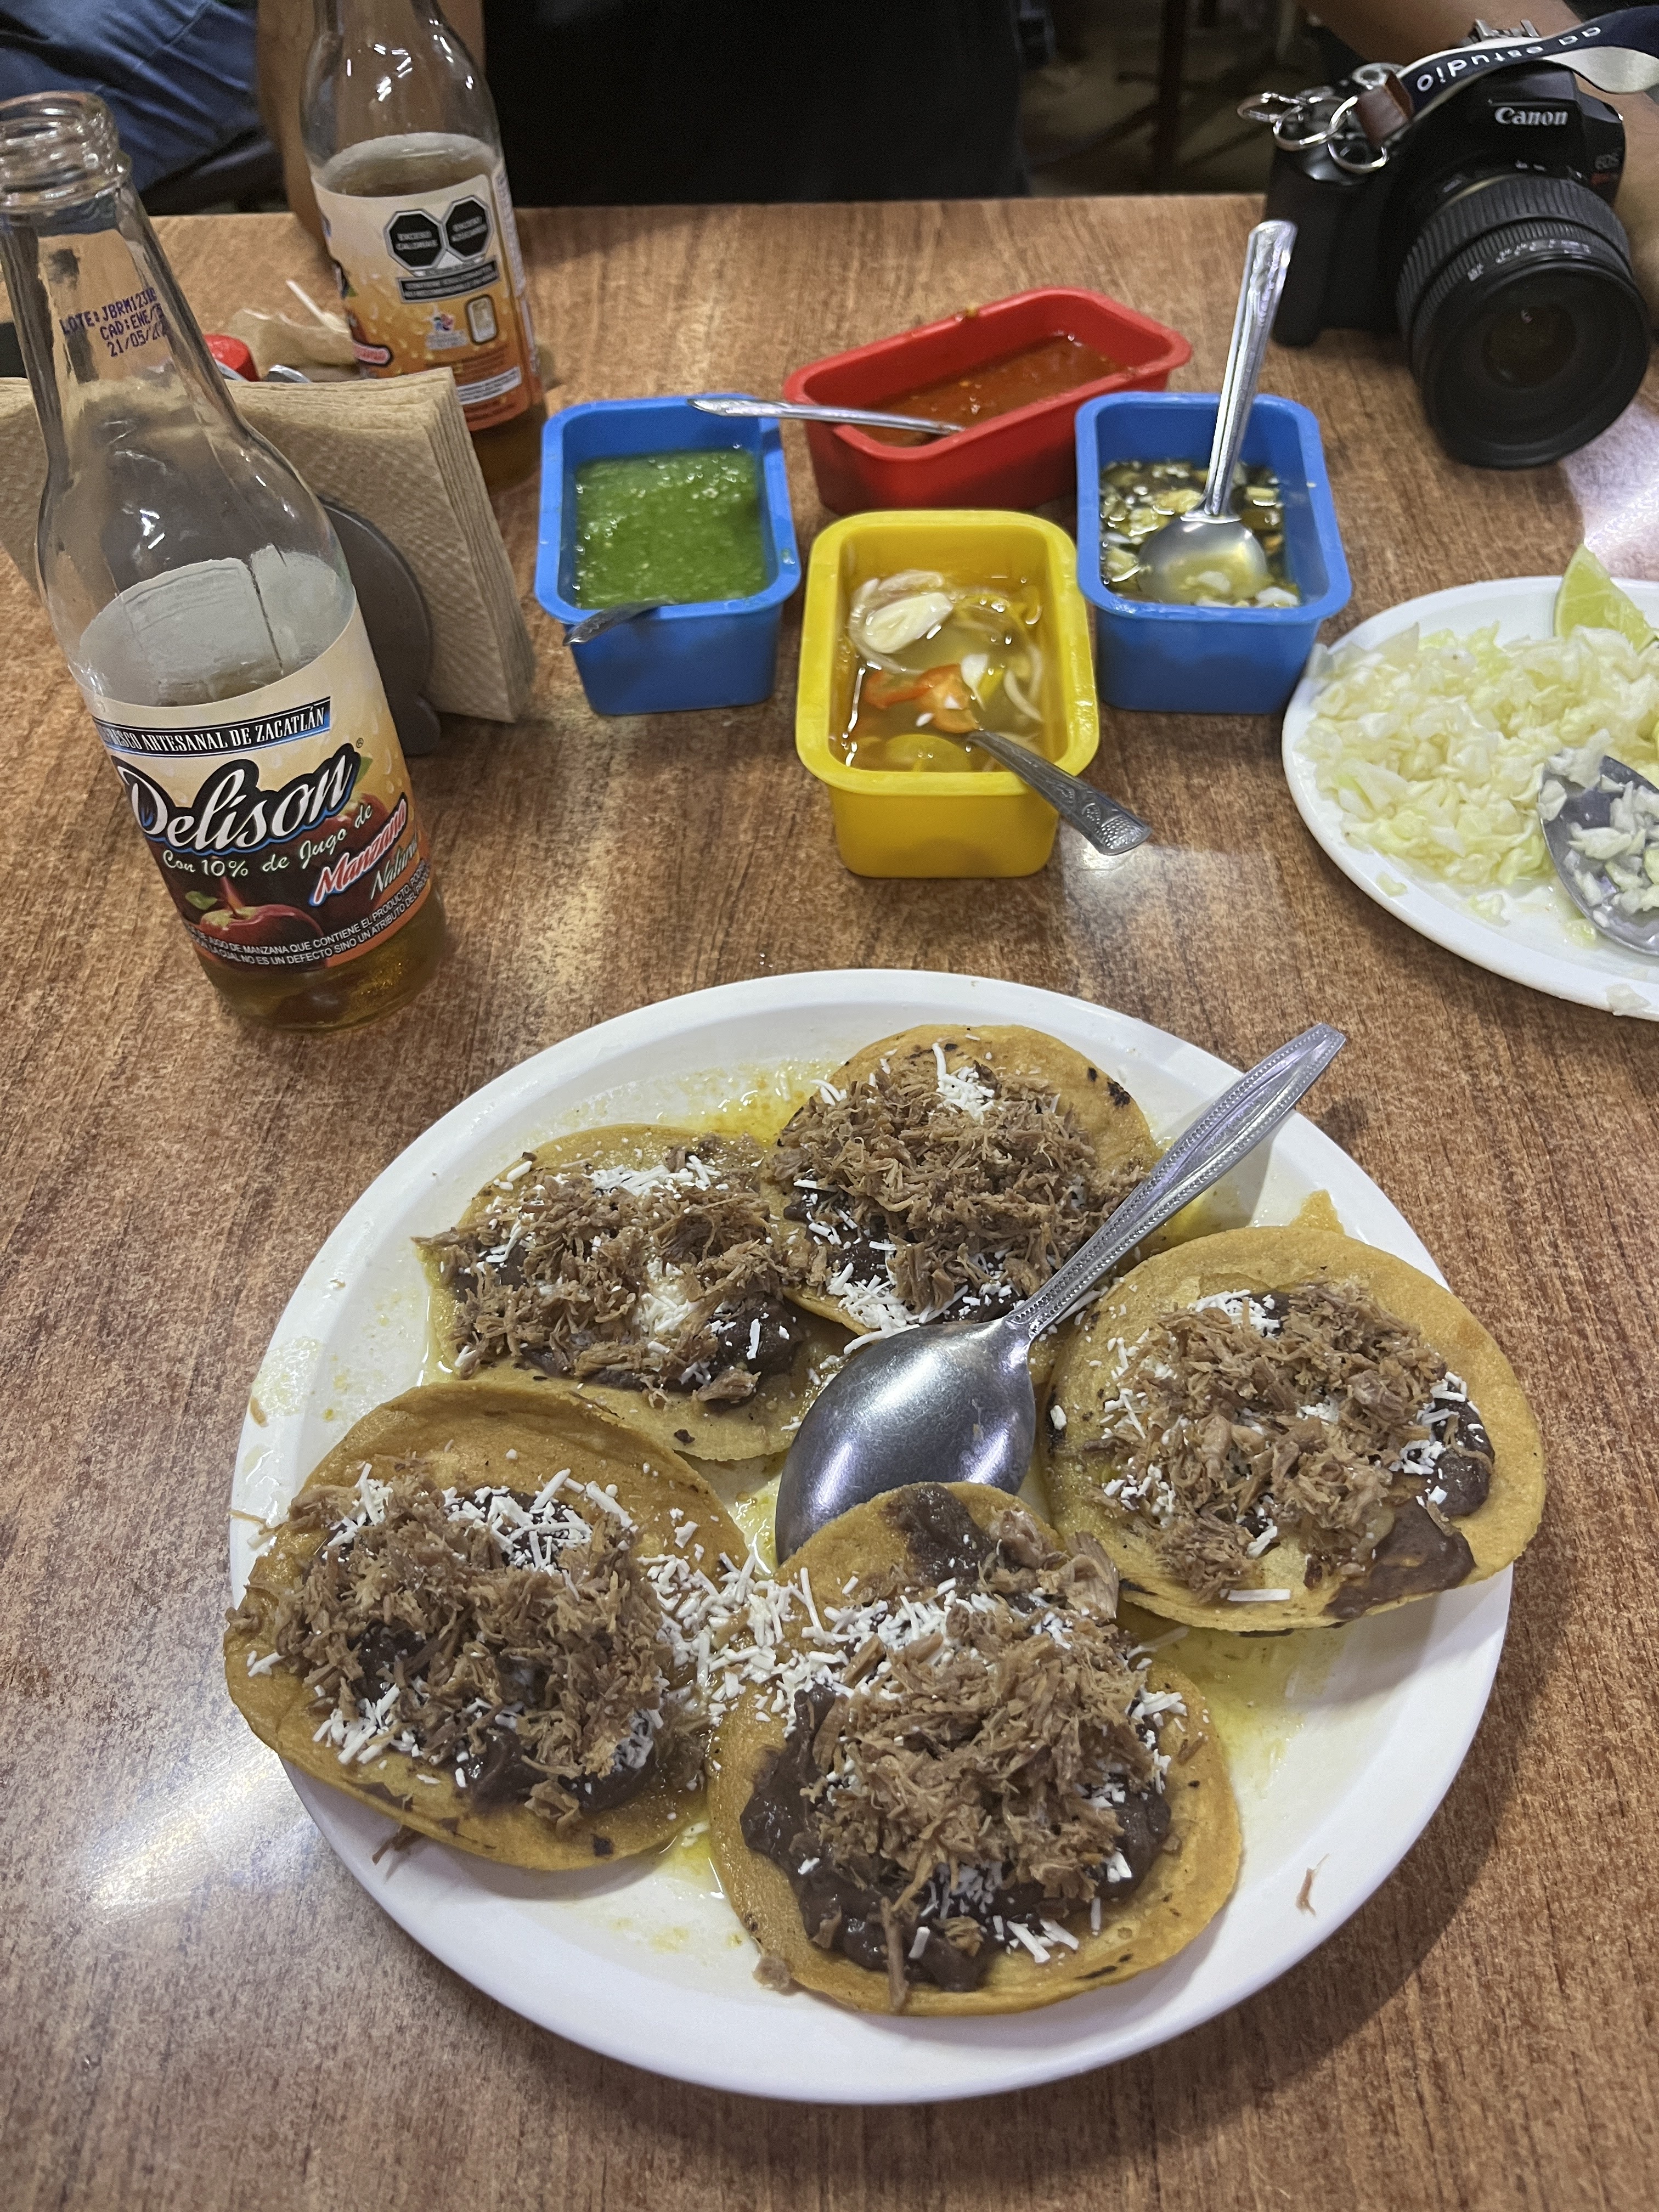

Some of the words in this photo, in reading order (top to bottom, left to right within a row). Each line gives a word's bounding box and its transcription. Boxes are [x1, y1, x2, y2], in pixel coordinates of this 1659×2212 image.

[1494, 106, 1568, 126] Canon
[141, 731, 228, 752] ARTESANAL
[229, 727, 252, 747] DE
[255, 706, 324, 743] ZACATLÁN
[117, 754, 353, 850] Delison
[162, 849, 196, 873] Con
[201, 859, 249, 877] 10%
[262, 854, 290, 872] de
[300, 828, 347, 870] Jugo
[354, 805, 373, 828] de
[313, 798, 407, 905] Manzana
[229, 943, 245, 952] DE
[242, 945, 290, 955] MANZANA
[290, 941, 312, 953] QUE
[313, 923, 362, 948] CONTIENE
[360, 917, 373, 929] EL
[241, 953, 256, 964] NO
[256, 956, 270, 965] ES
[270, 955, 285, 965] UN
[286, 947, 332, 964] DEFECTO
[334, 938, 357, 953] SINO
[357, 929, 371, 943] UN
[370, 902, 406, 936] ATRIBUTO
[404, 892, 417, 907] DEL
